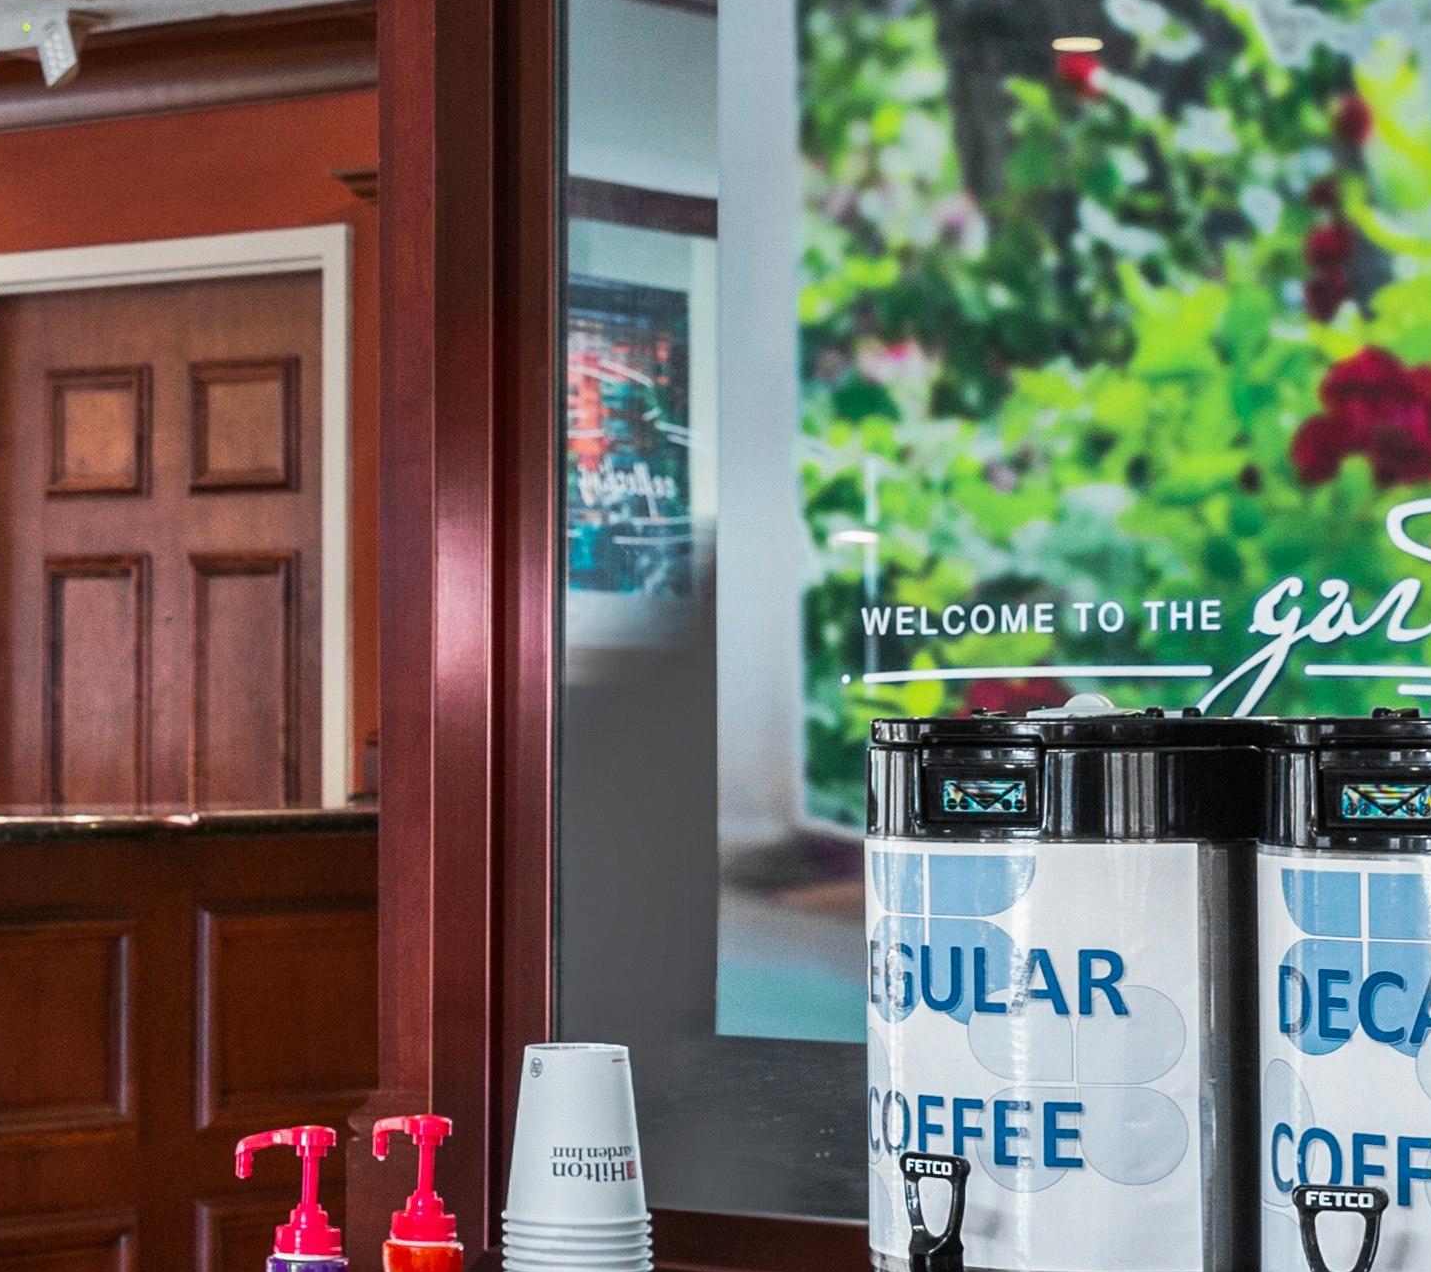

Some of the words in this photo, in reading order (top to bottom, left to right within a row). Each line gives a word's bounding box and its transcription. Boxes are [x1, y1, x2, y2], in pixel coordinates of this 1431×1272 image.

[860, 601, 1056, 637] WELCOME
[1072, 599, 1125, 634] TO
[1143, 598, 1223, 633] THE
[868, 938, 1129, 1018] EGULAR
[869, 1085, 1085, 1171] COFFEE
[552, 1147, 583, 1161] Inn
[552, 1161, 626, 1183] Hilton
[905, 1157, 953, 1176] FETCO
[1304, 1190, 1375, 1209] FETCO
